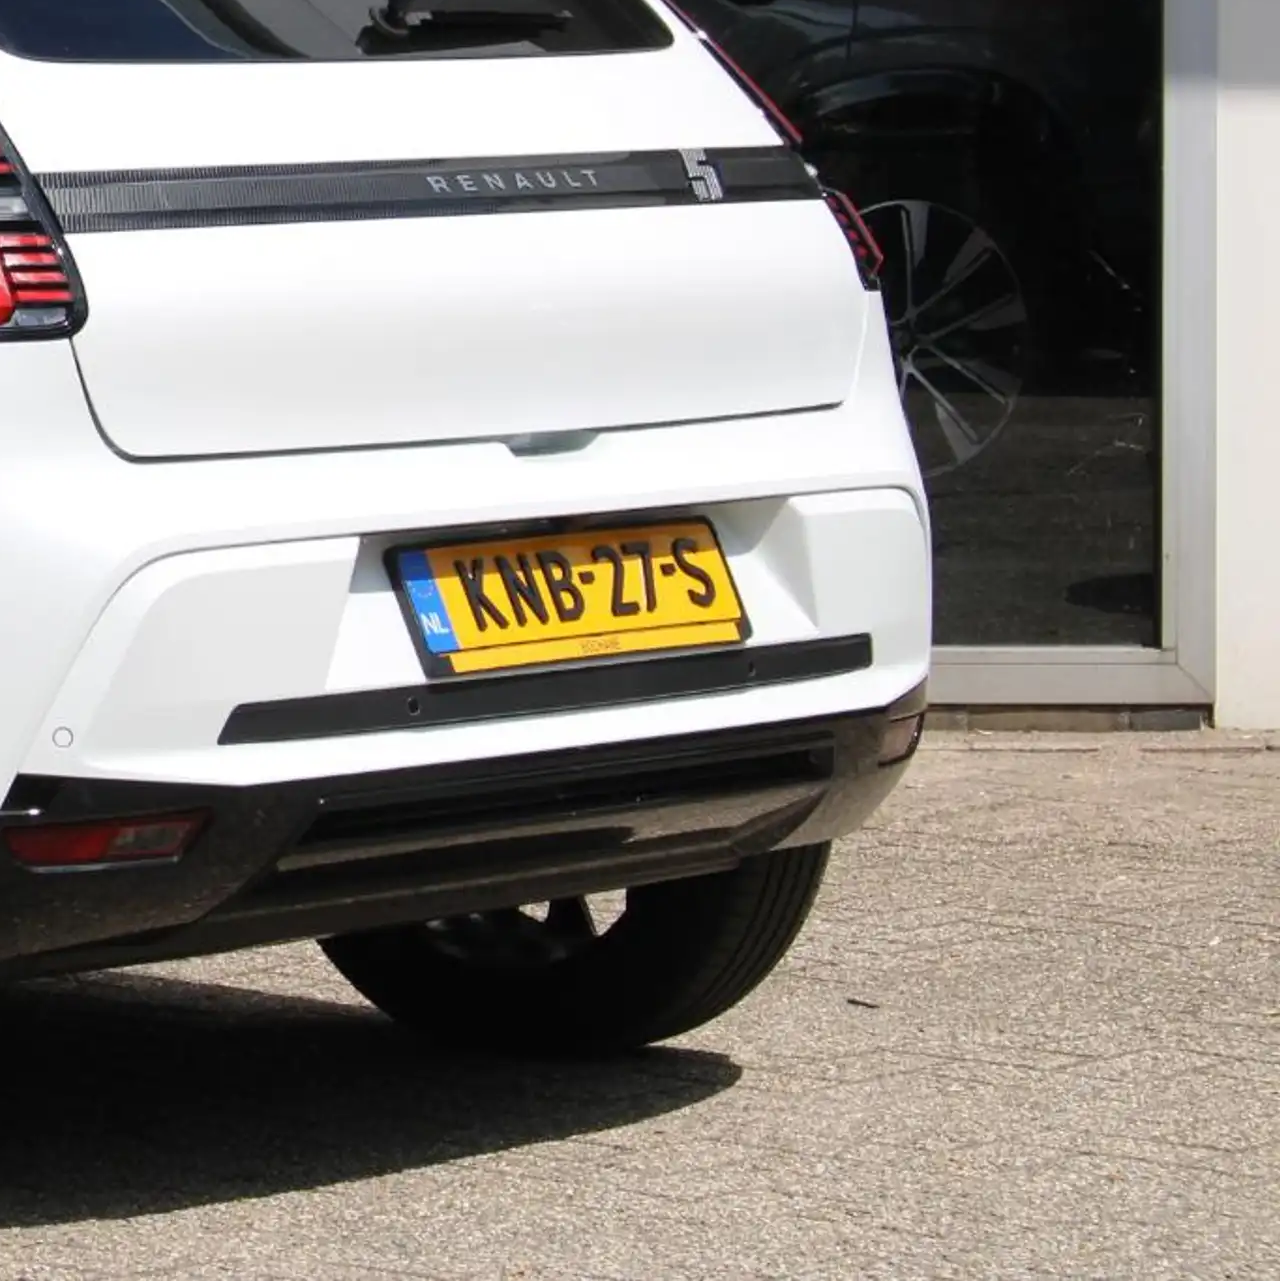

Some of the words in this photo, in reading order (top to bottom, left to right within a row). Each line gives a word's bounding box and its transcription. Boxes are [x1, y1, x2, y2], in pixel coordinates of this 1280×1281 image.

[426, 169, 599, 195] RENAULT
[453, 537, 717, 632] KNB-27-S
[422, 610, 450, 635] NL
